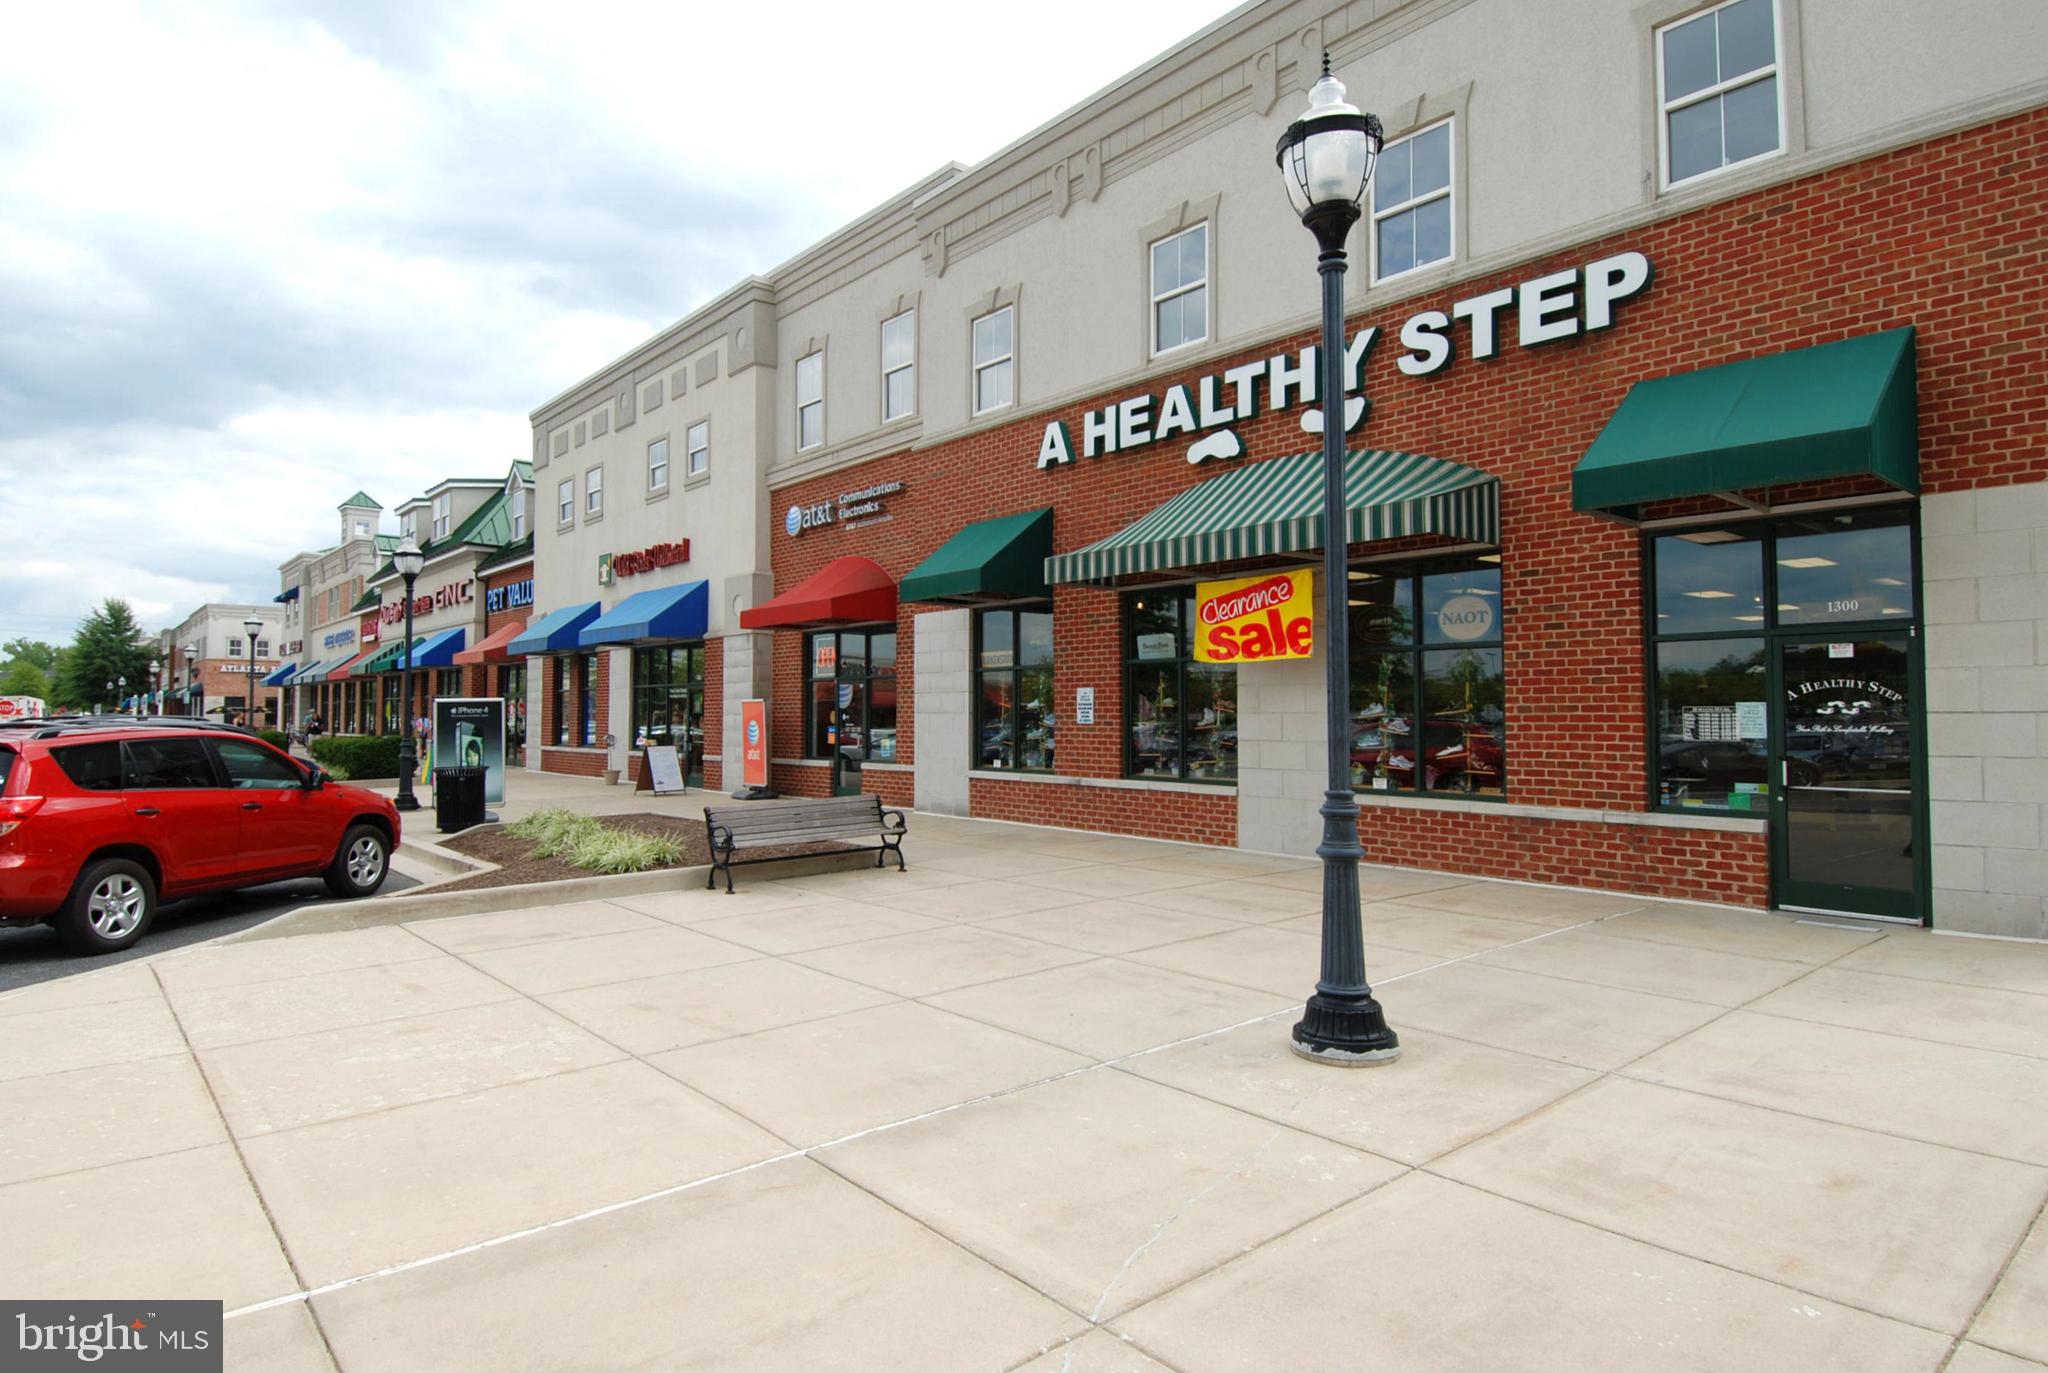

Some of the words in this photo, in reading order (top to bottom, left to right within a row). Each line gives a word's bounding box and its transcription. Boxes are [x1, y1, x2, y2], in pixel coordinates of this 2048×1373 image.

[1037, 421, 1073, 469] A
[1084, 327, 1380, 457] HEALTHY
[1398, 251, 1652, 376] STEP
[839, 481, 901, 504] Communications
[802, 500, 832, 529] at&t
[839, 502, 879, 519] Electronics
[434, 578, 474, 608] GNC
[488, 588, 505, 612] PET
[507, 579, 534, 606] VALU
[1202, 582, 1290, 624] Clearance
[1828, 600, 1859, 612] 1300
[1442, 610, 1488, 625] NAOT
[1207, 608, 1312, 660] sale
[1787, 689, 1799, 701] A
